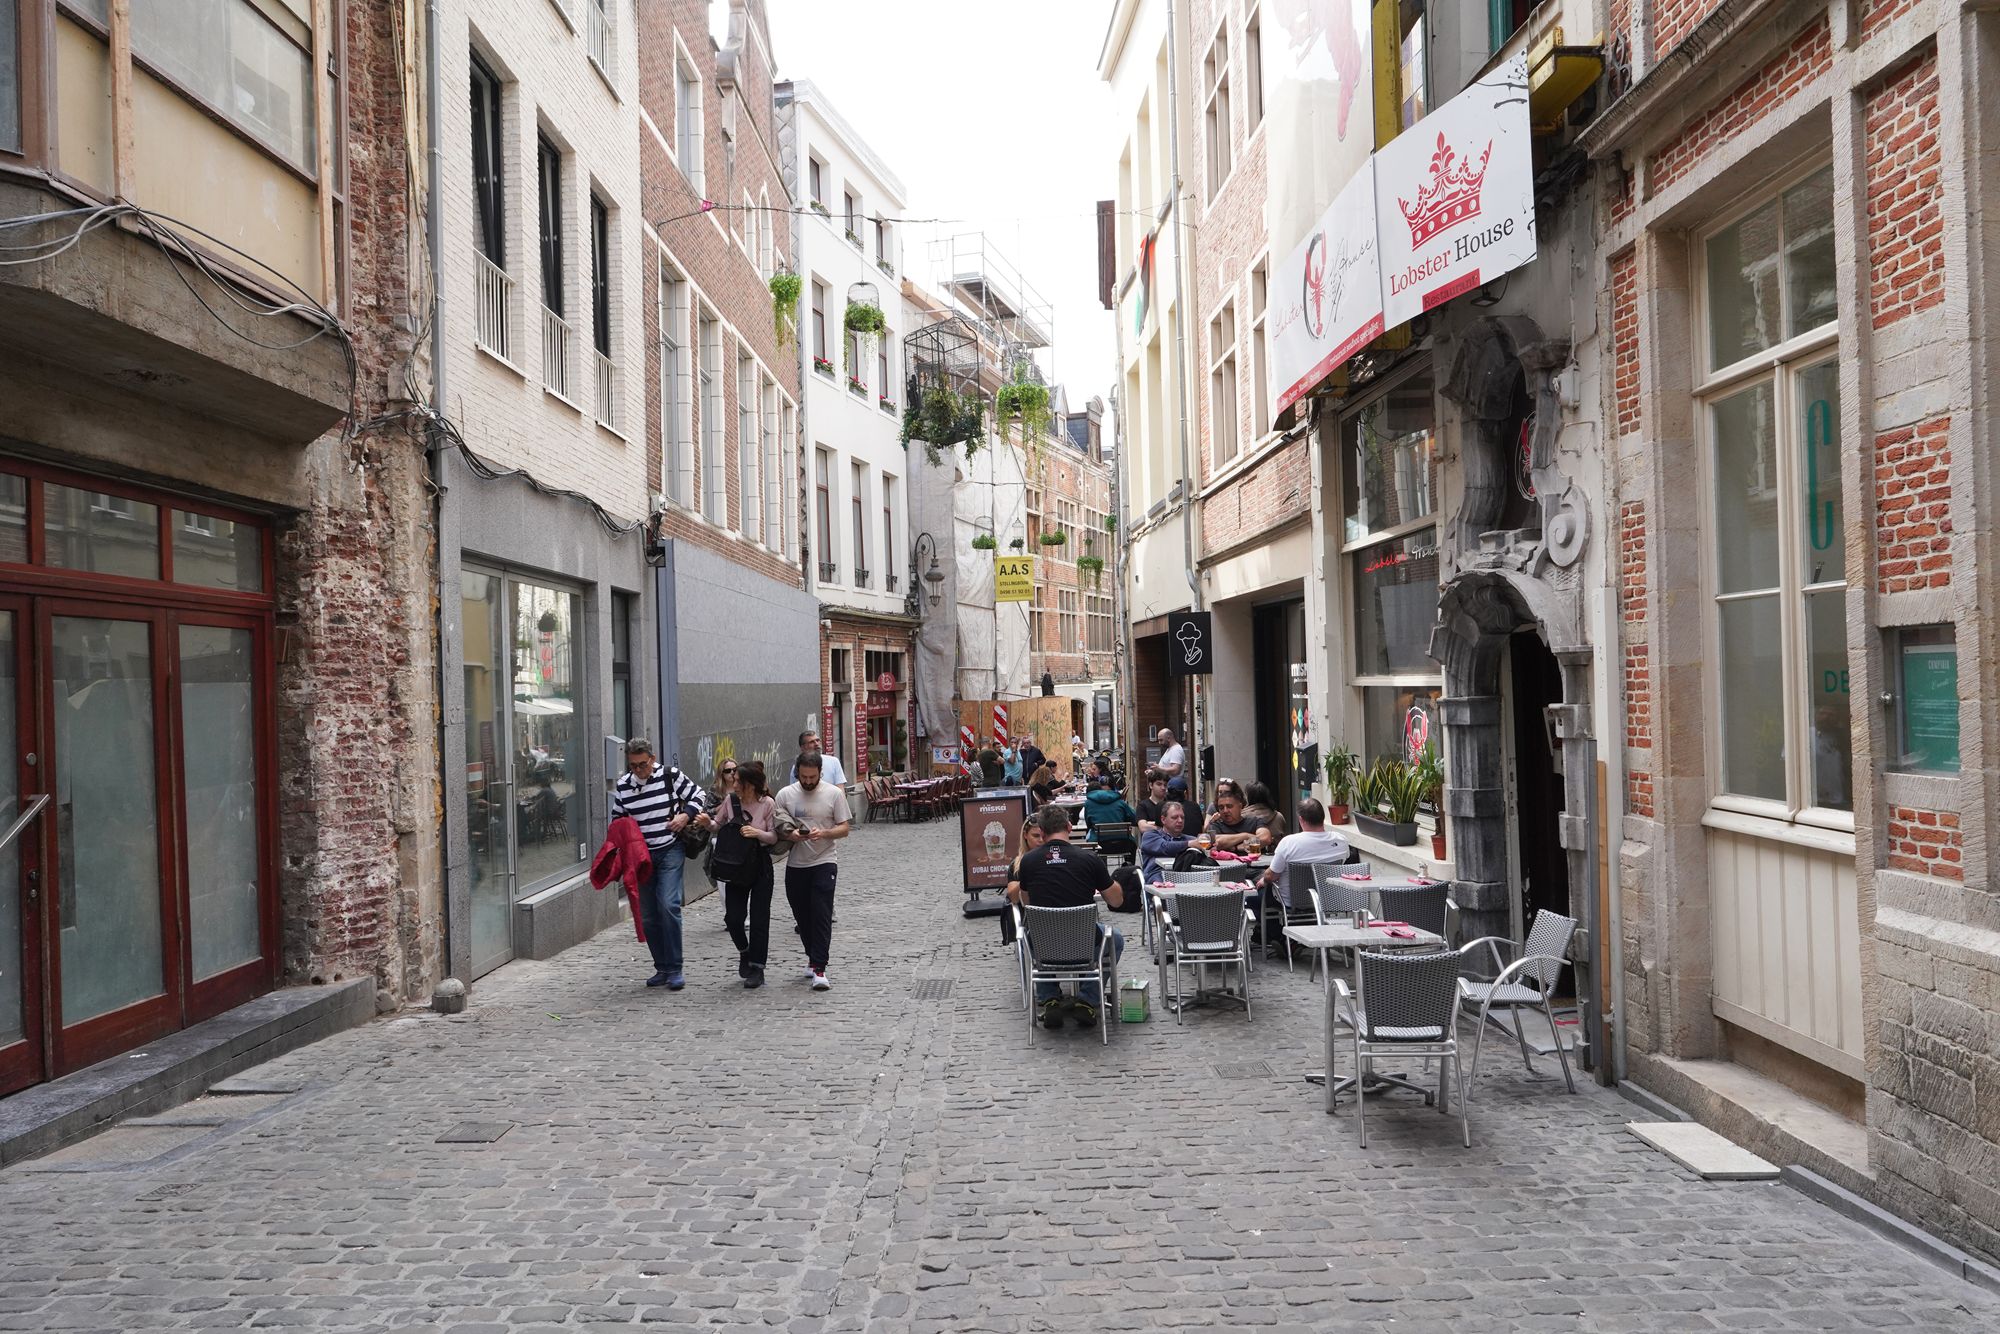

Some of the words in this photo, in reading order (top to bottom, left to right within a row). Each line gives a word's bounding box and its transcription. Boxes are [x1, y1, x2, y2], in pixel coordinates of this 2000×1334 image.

[1390, 250, 1451, 296] Lobster
[1454, 218, 1514, 262] House
[1000, 563, 1029, 576] A.A.S
[972, 865, 989, 874] DUBAI
